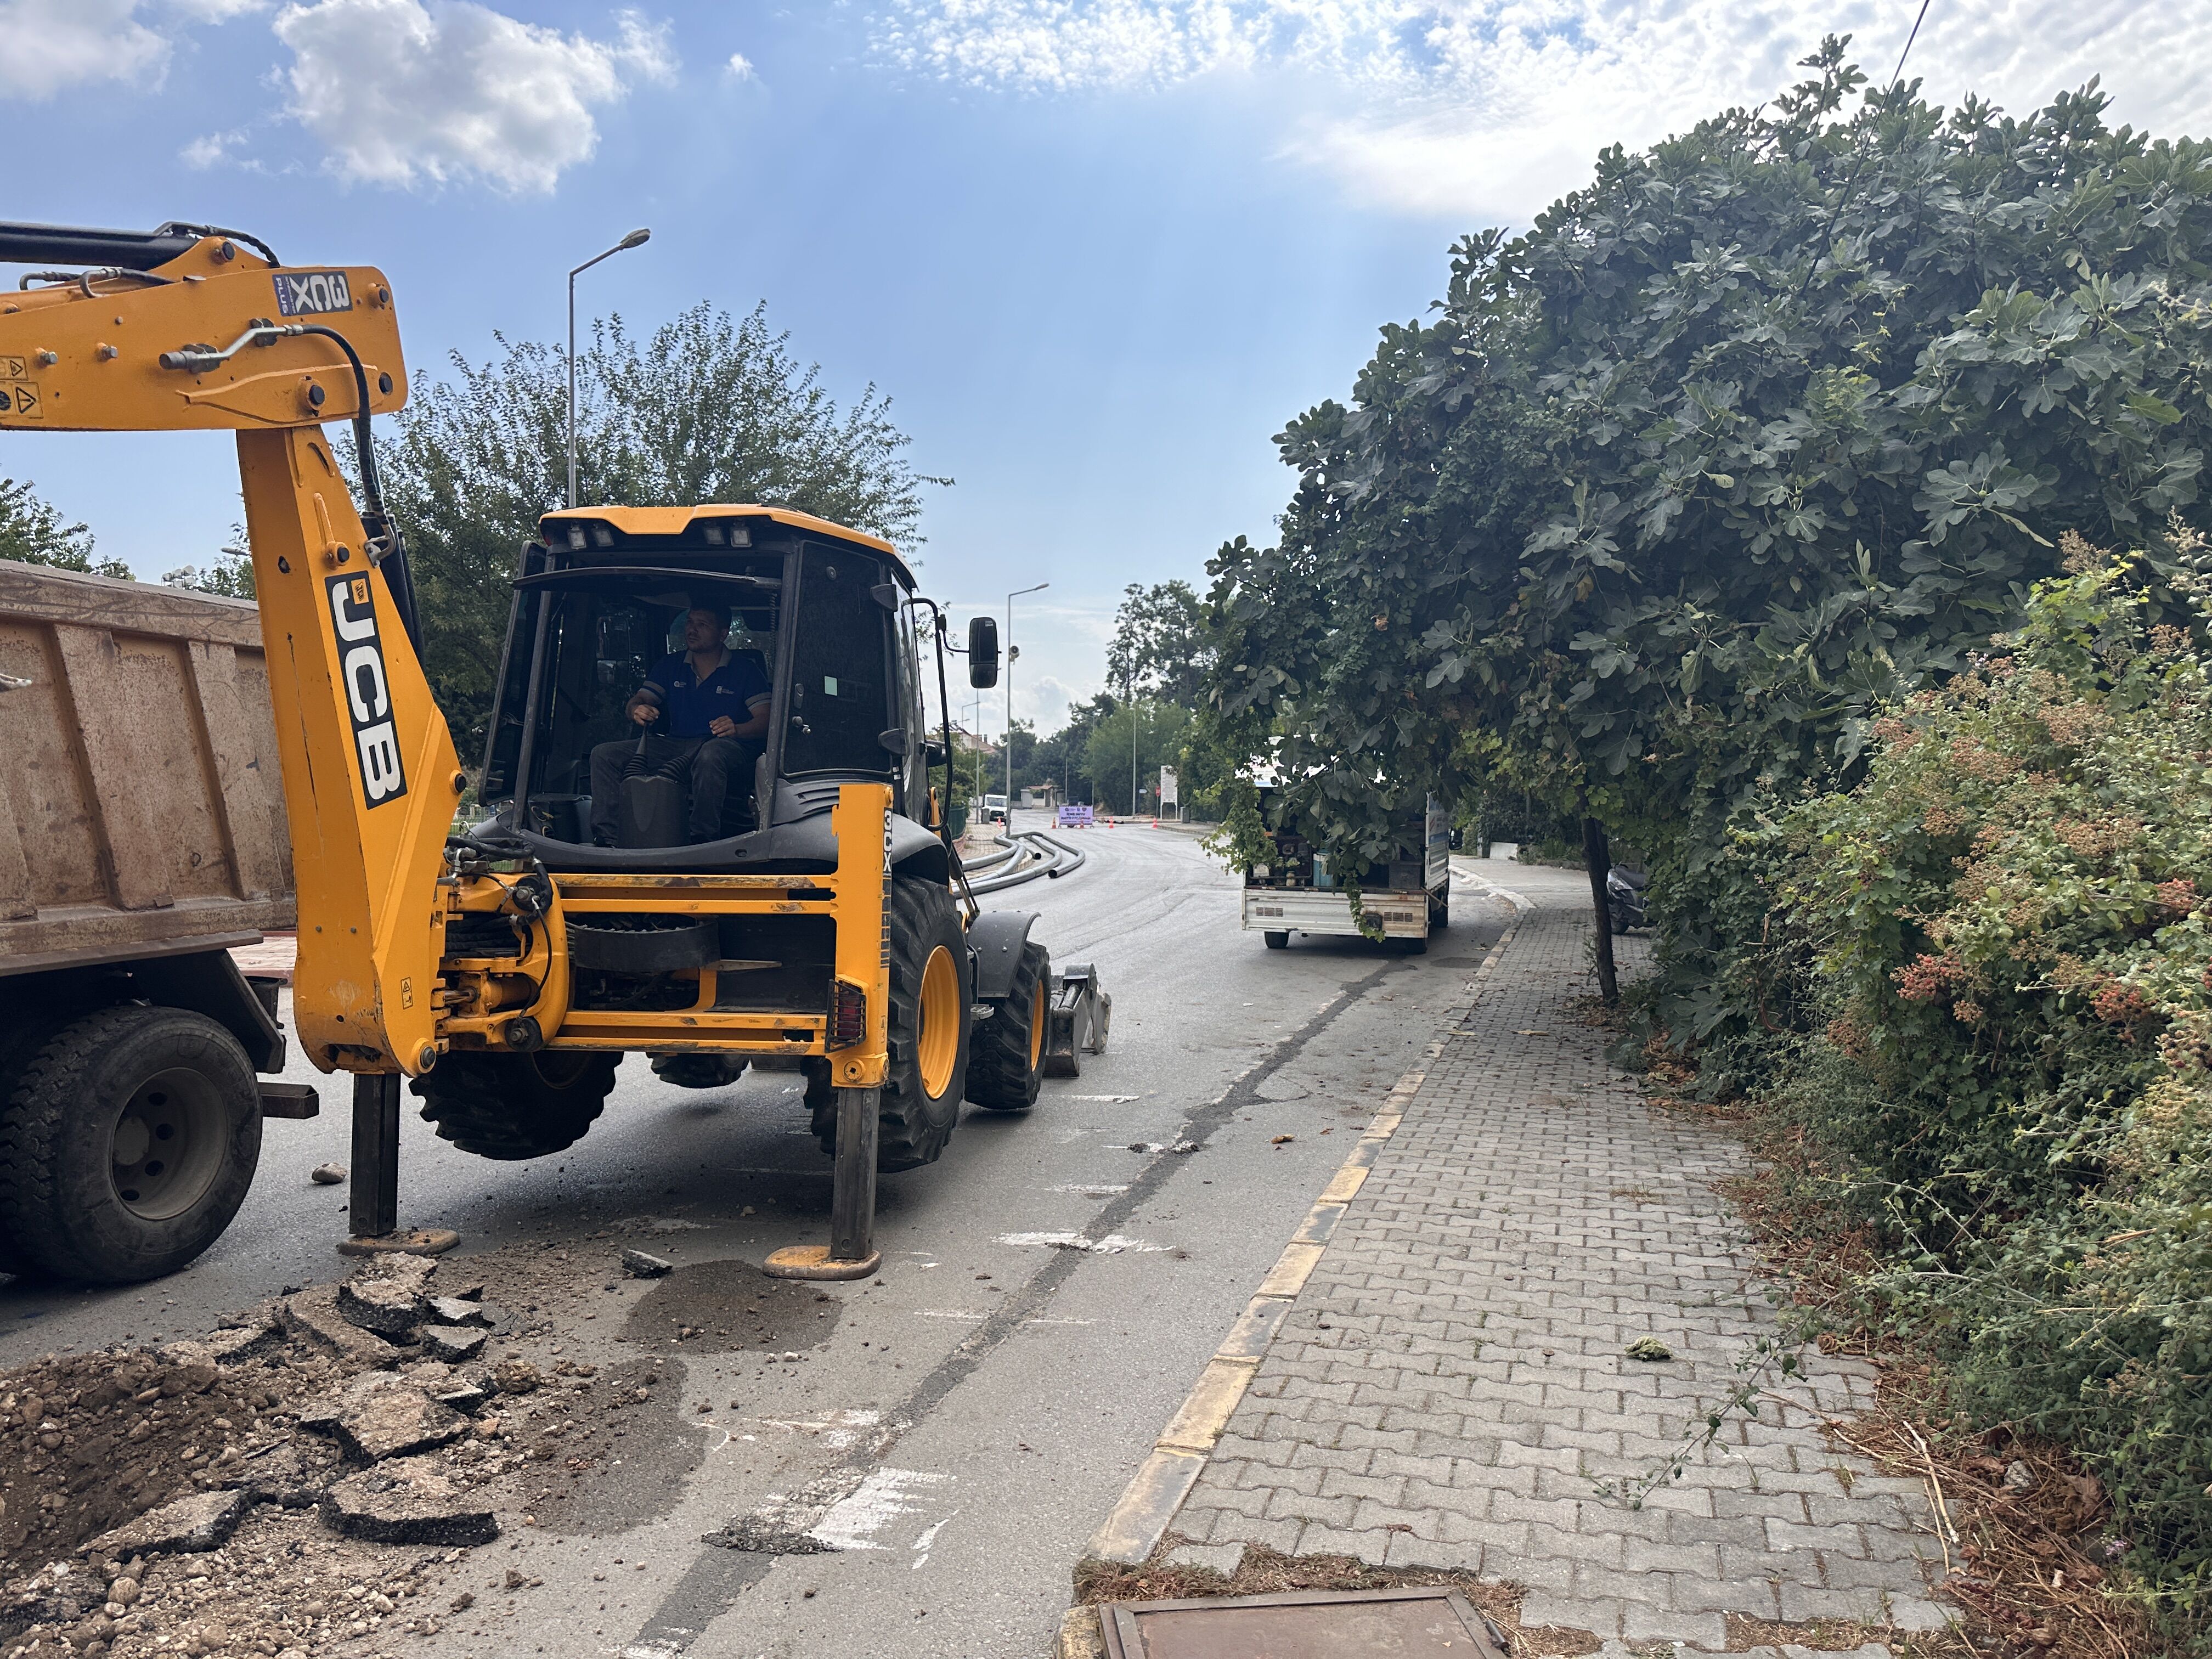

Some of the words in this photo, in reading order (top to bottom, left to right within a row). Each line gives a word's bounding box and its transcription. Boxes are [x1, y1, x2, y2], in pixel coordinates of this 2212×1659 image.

[275, 277, 289, 314] PLUS
[289, 275, 350, 313] 3CX
[354, 582, 364, 601] JCB
[332, 582, 401, 800] JCB
[883, 810, 892, 872] 3CX
